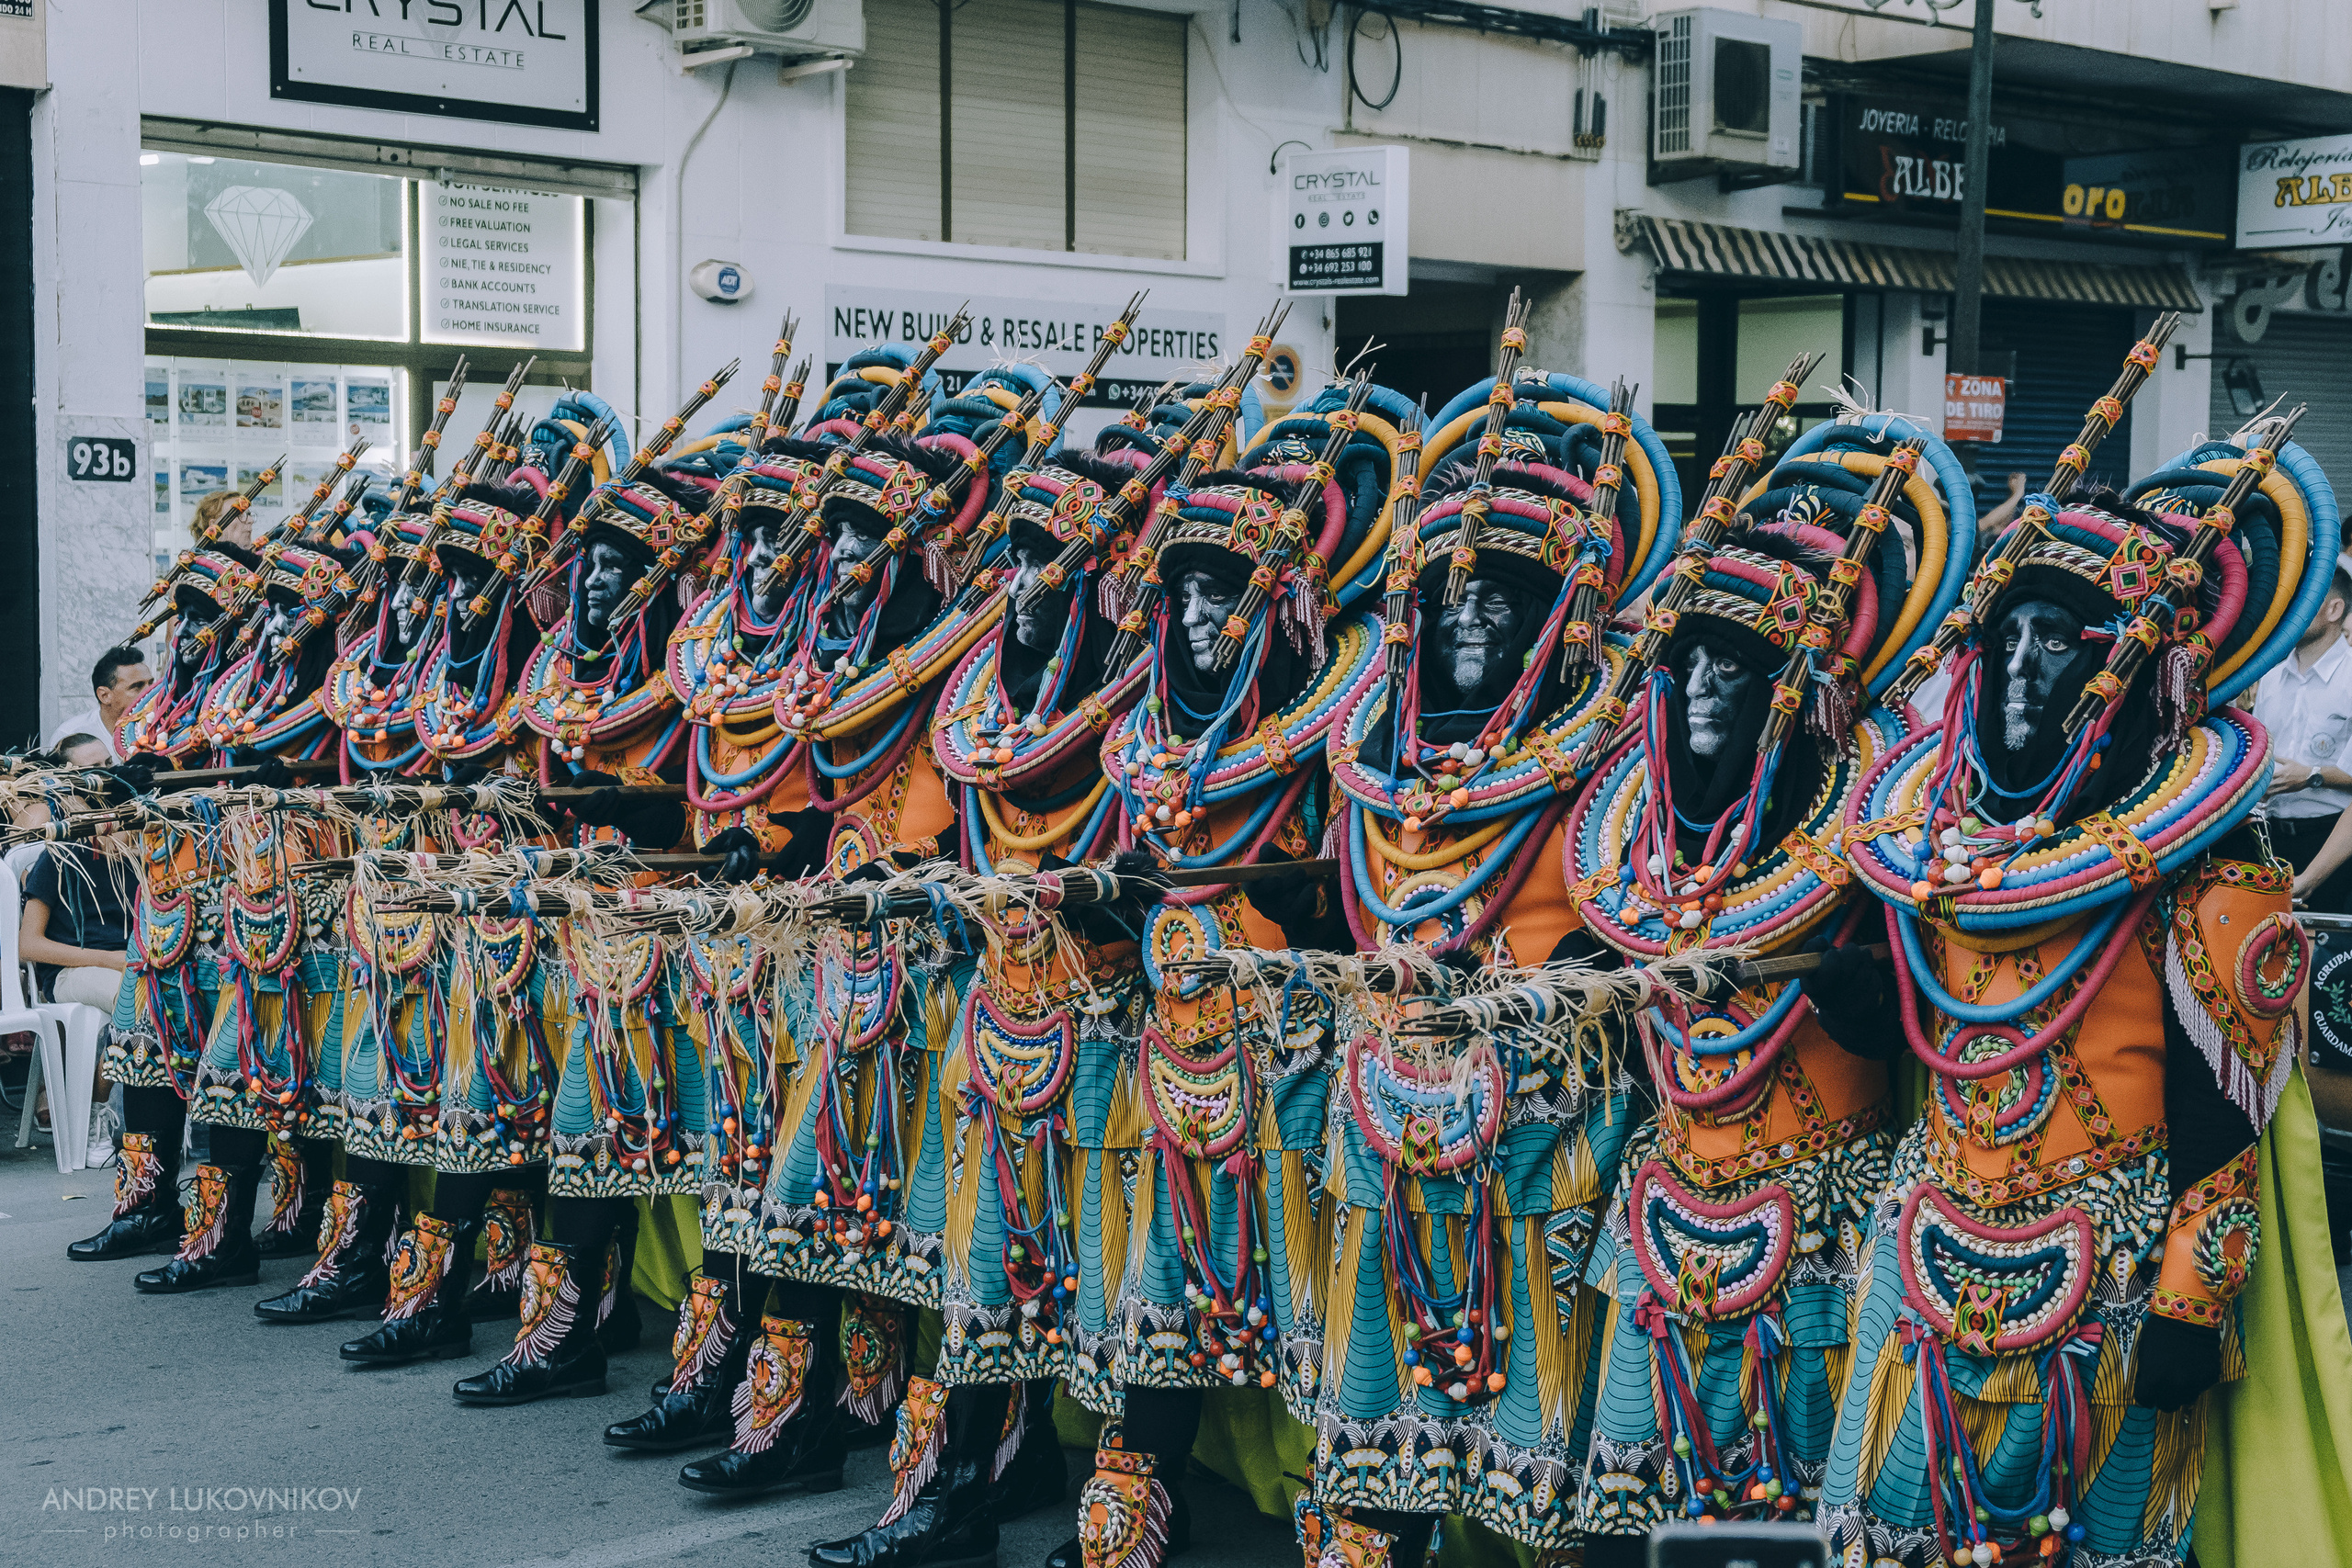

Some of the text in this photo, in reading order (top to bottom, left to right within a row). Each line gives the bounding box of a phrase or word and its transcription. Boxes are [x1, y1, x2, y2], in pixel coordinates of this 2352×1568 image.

[15, 6, 24, 15] 24
[26, 6, 32, 17] H
[305, 0, 566, 40] YSTAL
[352, 33, 525, 67] REAL ESTATE
[1860, 108, 1919, 136] JOYERIA
[1295, 170, 1381, 190] CRYSTAL
[449, 197, 529, 213] NO SALE NO FEE
[2063, 184, 2126, 220] oro
[450, 218, 531, 233] FREE VALUATION
[450, 238, 529, 253] LEGAL SERVICES
[1309, 246, 1372, 259] +34 865 685 921
[451, 258, 551, 275] NIE, TIE & RESIDENCY
[1308, 260, 1373, 274] +34 692 253 100
[451, 278, 536, 293] BANK ACCOUNTS
[453, 299, 560, 315] TRANSLATION SERVICE
[452, 320, 540, 334] HOME INSURANCE
[834, 306, 894, 340] NEW
[980, 316, 995, 345] &
[1003, 318, 1085, 352] RESALE
[1093, 324, 1218, 359] POPERTIES
[1961, 379, 2002, 396] ZONA
[1946, 400, 2003, 419] DE TIRO
[73, 442, 131, 477] 93b
[2313, 949, 2352, 990] AGRUPA
